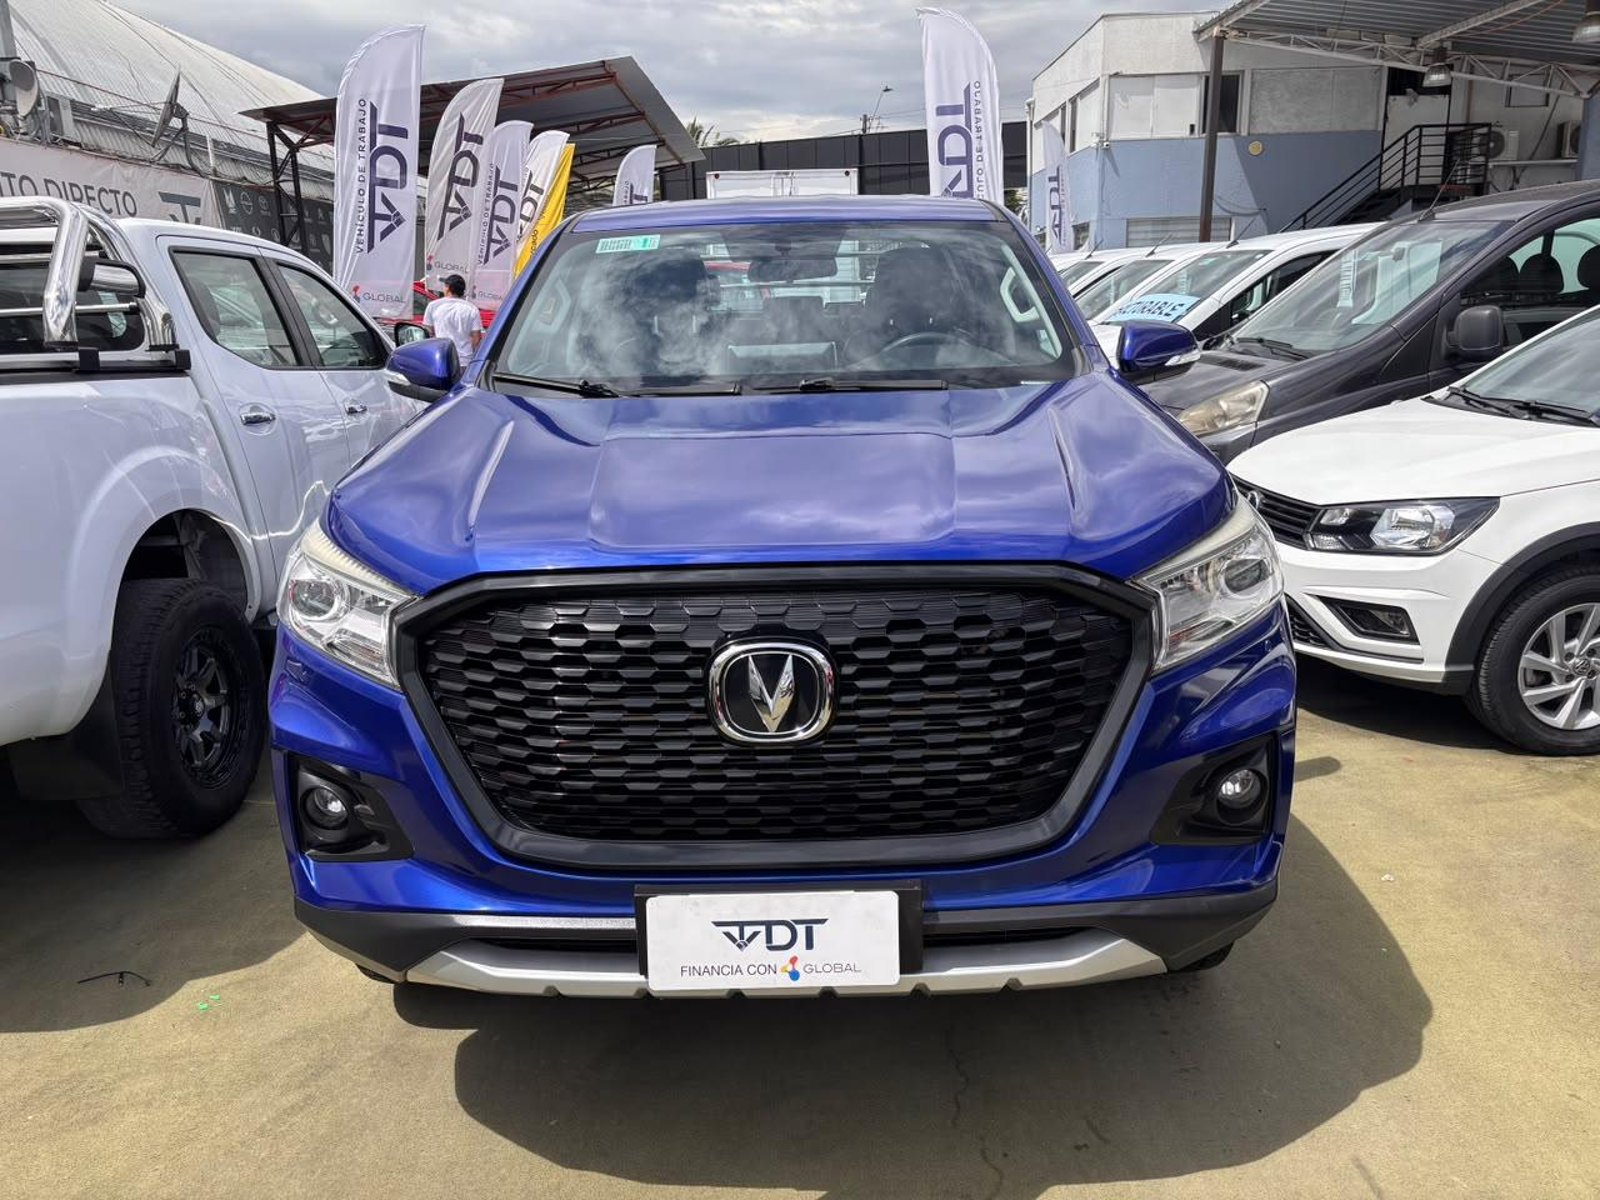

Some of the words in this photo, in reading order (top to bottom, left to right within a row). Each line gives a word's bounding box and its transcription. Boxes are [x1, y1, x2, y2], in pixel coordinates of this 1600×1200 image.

[358, 98, 367, 160] TRABAJO
[358, 166, 366, 183] DE
[0, 171, 38, 197] TO
[43, 178, 138, 217] DIRECTO
[711, 918, 829, 952] VDT
[680, 964, 744, 977] FINANCIA
[746, 963, 777, 976] CON
[802, 962, 862, 975] GLOBAL
